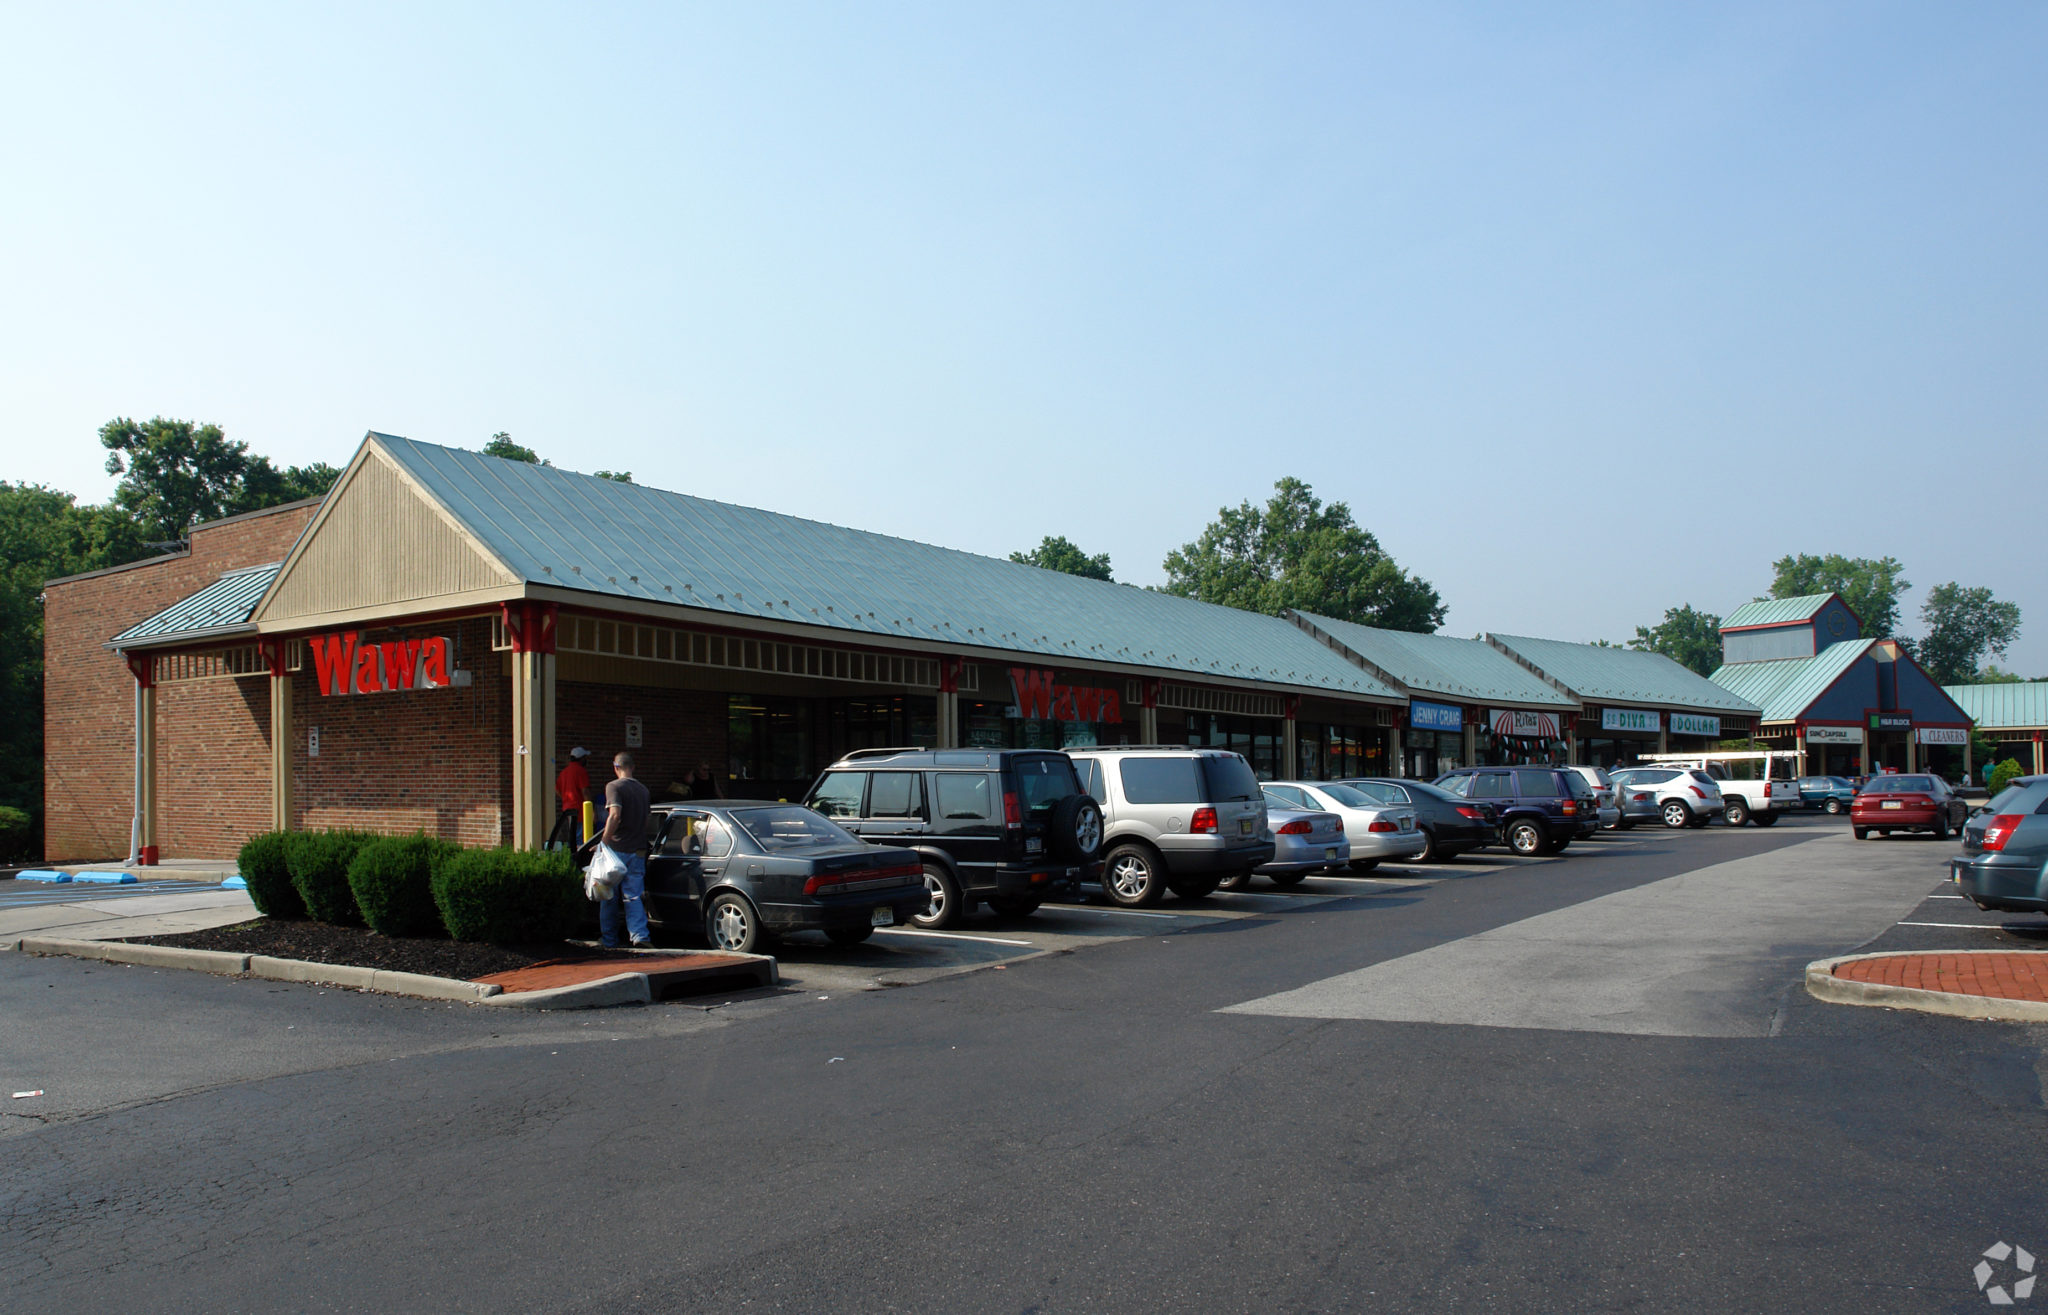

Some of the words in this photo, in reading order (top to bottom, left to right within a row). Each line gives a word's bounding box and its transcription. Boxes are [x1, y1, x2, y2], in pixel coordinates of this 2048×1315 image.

[309, 630, 451, 697] Wawa
[1009, 667, 1123, 724] Wawa
[1414, 706, 1438, 724] JENNY
[1439, 709, 1459, 726] CRAIG
[1514, 711, 1537, 728] Rita's
[1619, 712, 1645, 728] DIVA
[1893, 718, 1911, 726] BLOCK
[1928, 730, 1964, 742] CLEANERS
